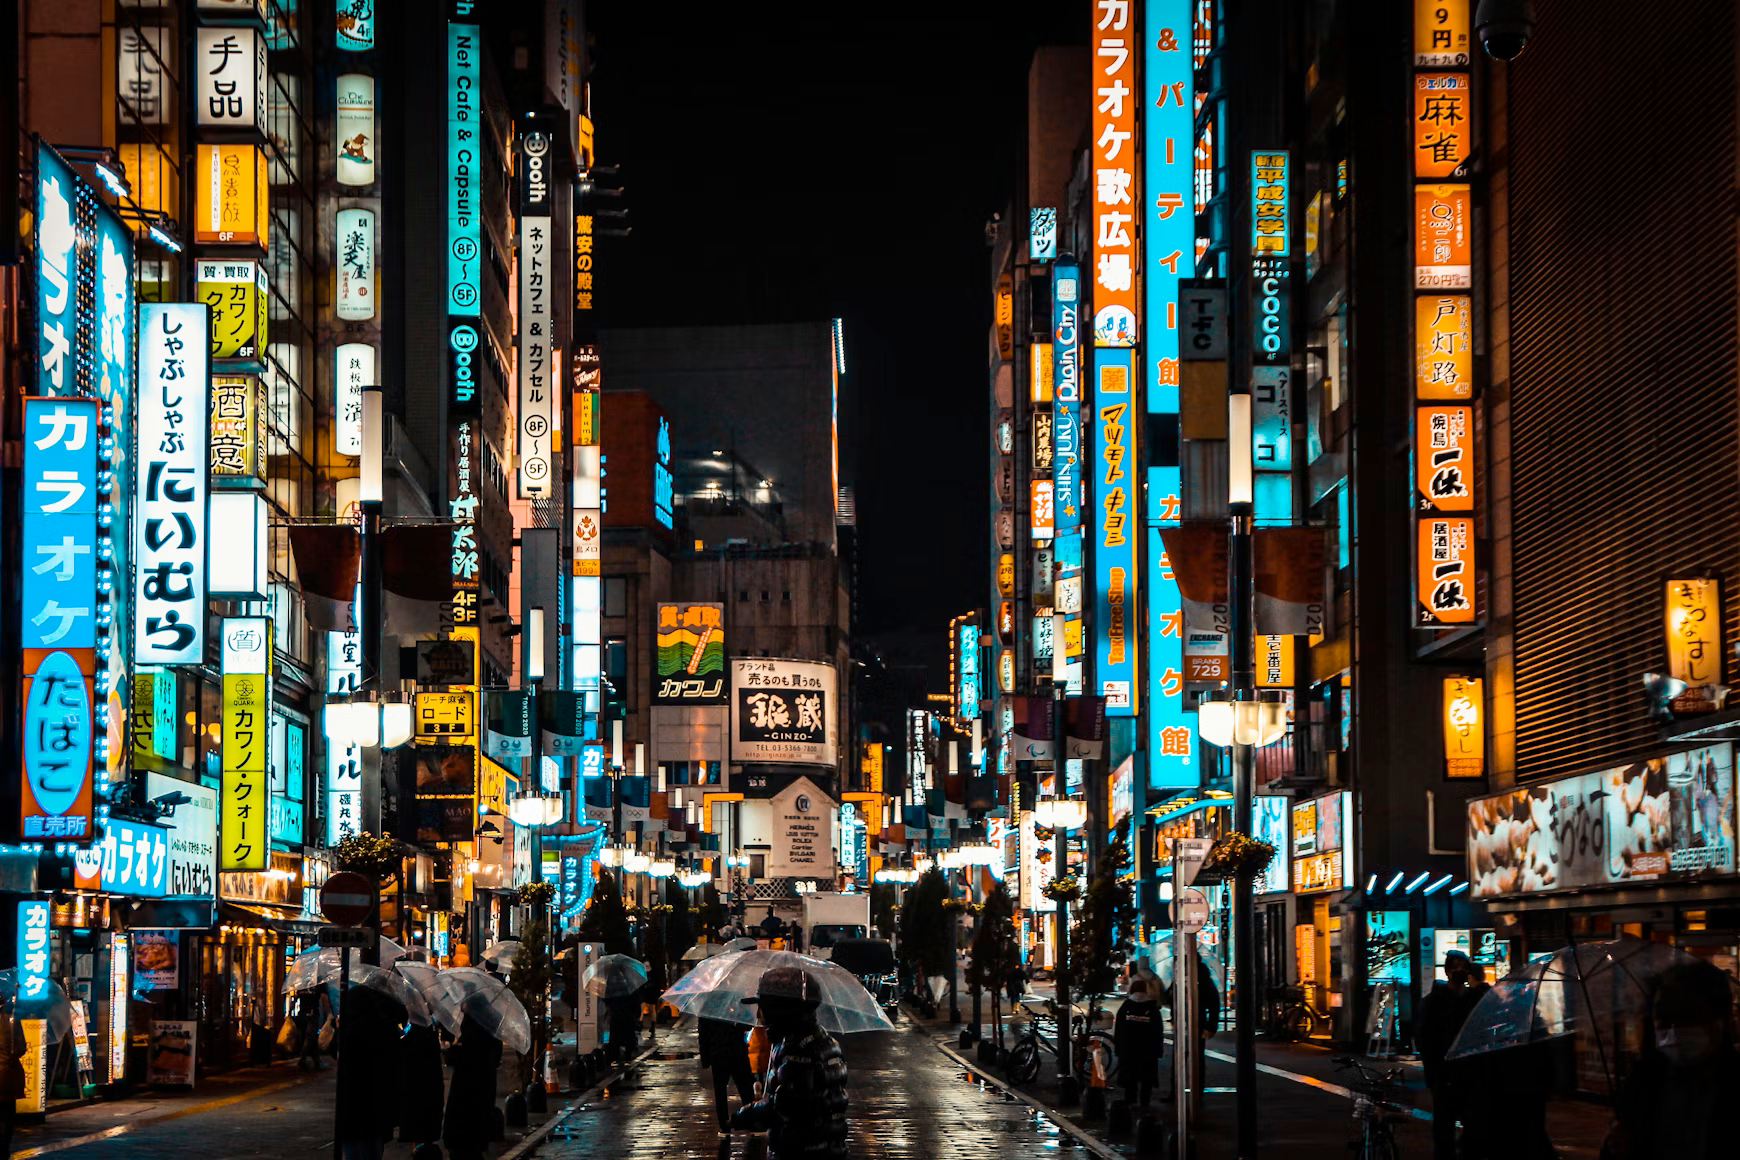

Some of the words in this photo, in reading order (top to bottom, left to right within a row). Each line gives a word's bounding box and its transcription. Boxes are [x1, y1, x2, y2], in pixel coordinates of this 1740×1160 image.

[1432, 0, 1453, 48] 9円
[456, 35, 473, 69] Net
[209, 35, 243, 118] 手品
[1417, 76, 1469, 90] ウェルカム
[456, 75, 473, 122] Cafe
[457, 128, 473, 142] &
[1096, 0, 1132, 292] カラオケ歌広場
[1418, 93, 1464, 164] 麻雀
[455, 149, 473, 228] Capsule
[524, 131, 548, 203] Booth
[218, 231, 234, 241] 6F
[529, 226, 544, 315] ネットカフェ
[576, 214, 593, 310] 驚安の殿堂
[529, 322, 543, 336] &
[1261, 278, 1281, 353] COCO
[239, 346, 255, 357] 5F
[450, 324, 478, 402] Booth
[529, 343, 544, 403] カプセル
[158, 312, 187, 454] しゃぶしゃぶ
[1102, 368, 1125, 391] 薬
[1057, 417, 1078, 502] SHINJUKU
[31, 405, 91, 646] カラオケ
[1432, 522, 1449, 561] 居酒屋
[143, 461, 197, 652] にいむら
[452, 591, 477, 606] 4F
[1108, 566, 1126, 604] Shop
[452, 607, 477, 622] 3F
[1108, 604, 1125, 638] Free
[1108, 639, 1125, 666] Tax
[1187, 634, 1224, 642] EXCHANGE
[657, 678, 723, 698] カワノ
[738, 662, 776, 672] ブランド品
[748, 673, 790, 686] 売るのも
[791, 673, 822, 688] 買うのも
[1192, 666, 1222, 678] 729
[422, 706, 467, 721] ロード
[423, 695, 467, 705] リーチ麻雀
[37, 670, 82, 793] たばこ
[233, 709, 254, 863] カワノ・クォーク
[24, 816, 89, 838] 直売所
[101, 826, 166, 889] カラオケ
[565, 857, 577, 905] カラオケ
[24, 905, 48, 997] カラオケ
